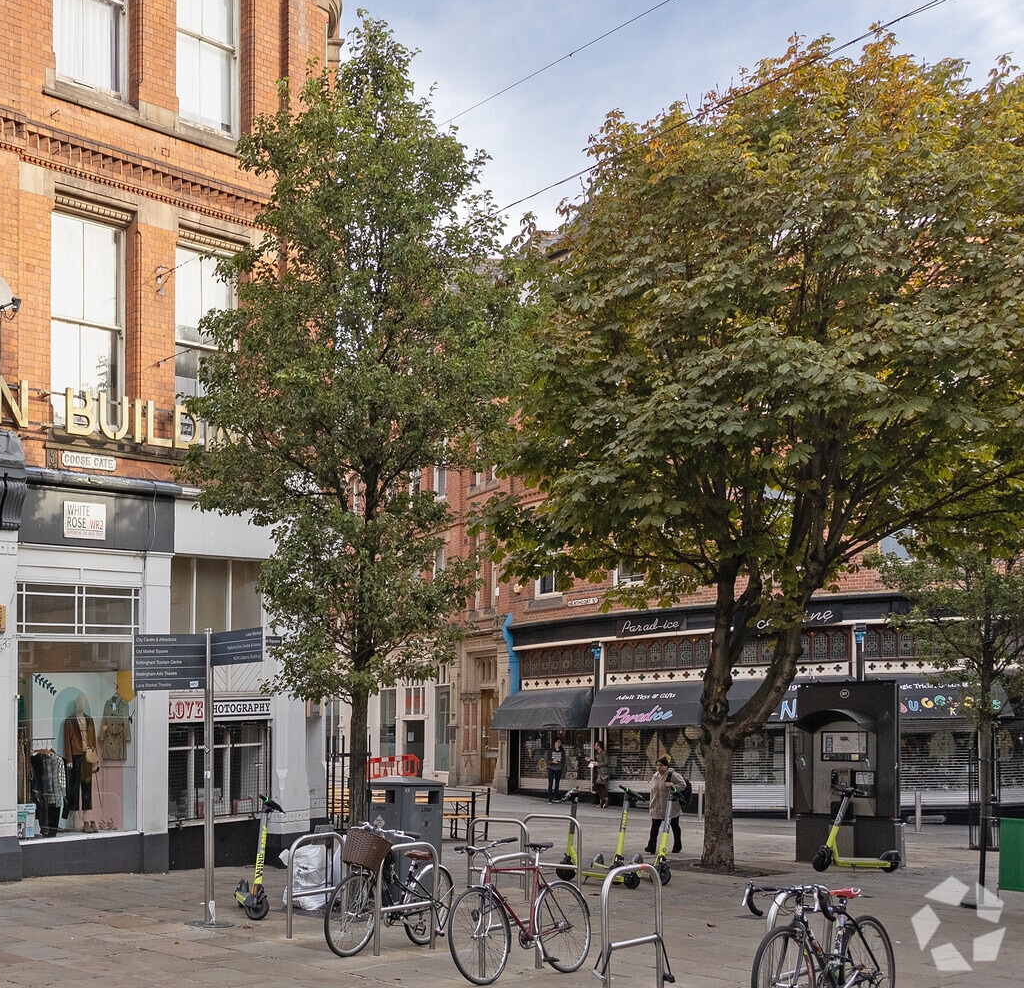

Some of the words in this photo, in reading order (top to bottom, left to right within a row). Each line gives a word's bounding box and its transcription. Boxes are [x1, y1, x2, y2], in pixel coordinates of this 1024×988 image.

[64, 454, 91, 466] GOOSE
[94, 458, 114, 469] GATE
[67, 504, 90, 516] WHITE
[66, 516, 86, 528] ROSE
[90, 520, 104, 530] WR2
[169, 700, 203, 719] LOVE
[214, 703, 270, 713] HOTOGRAPHY
